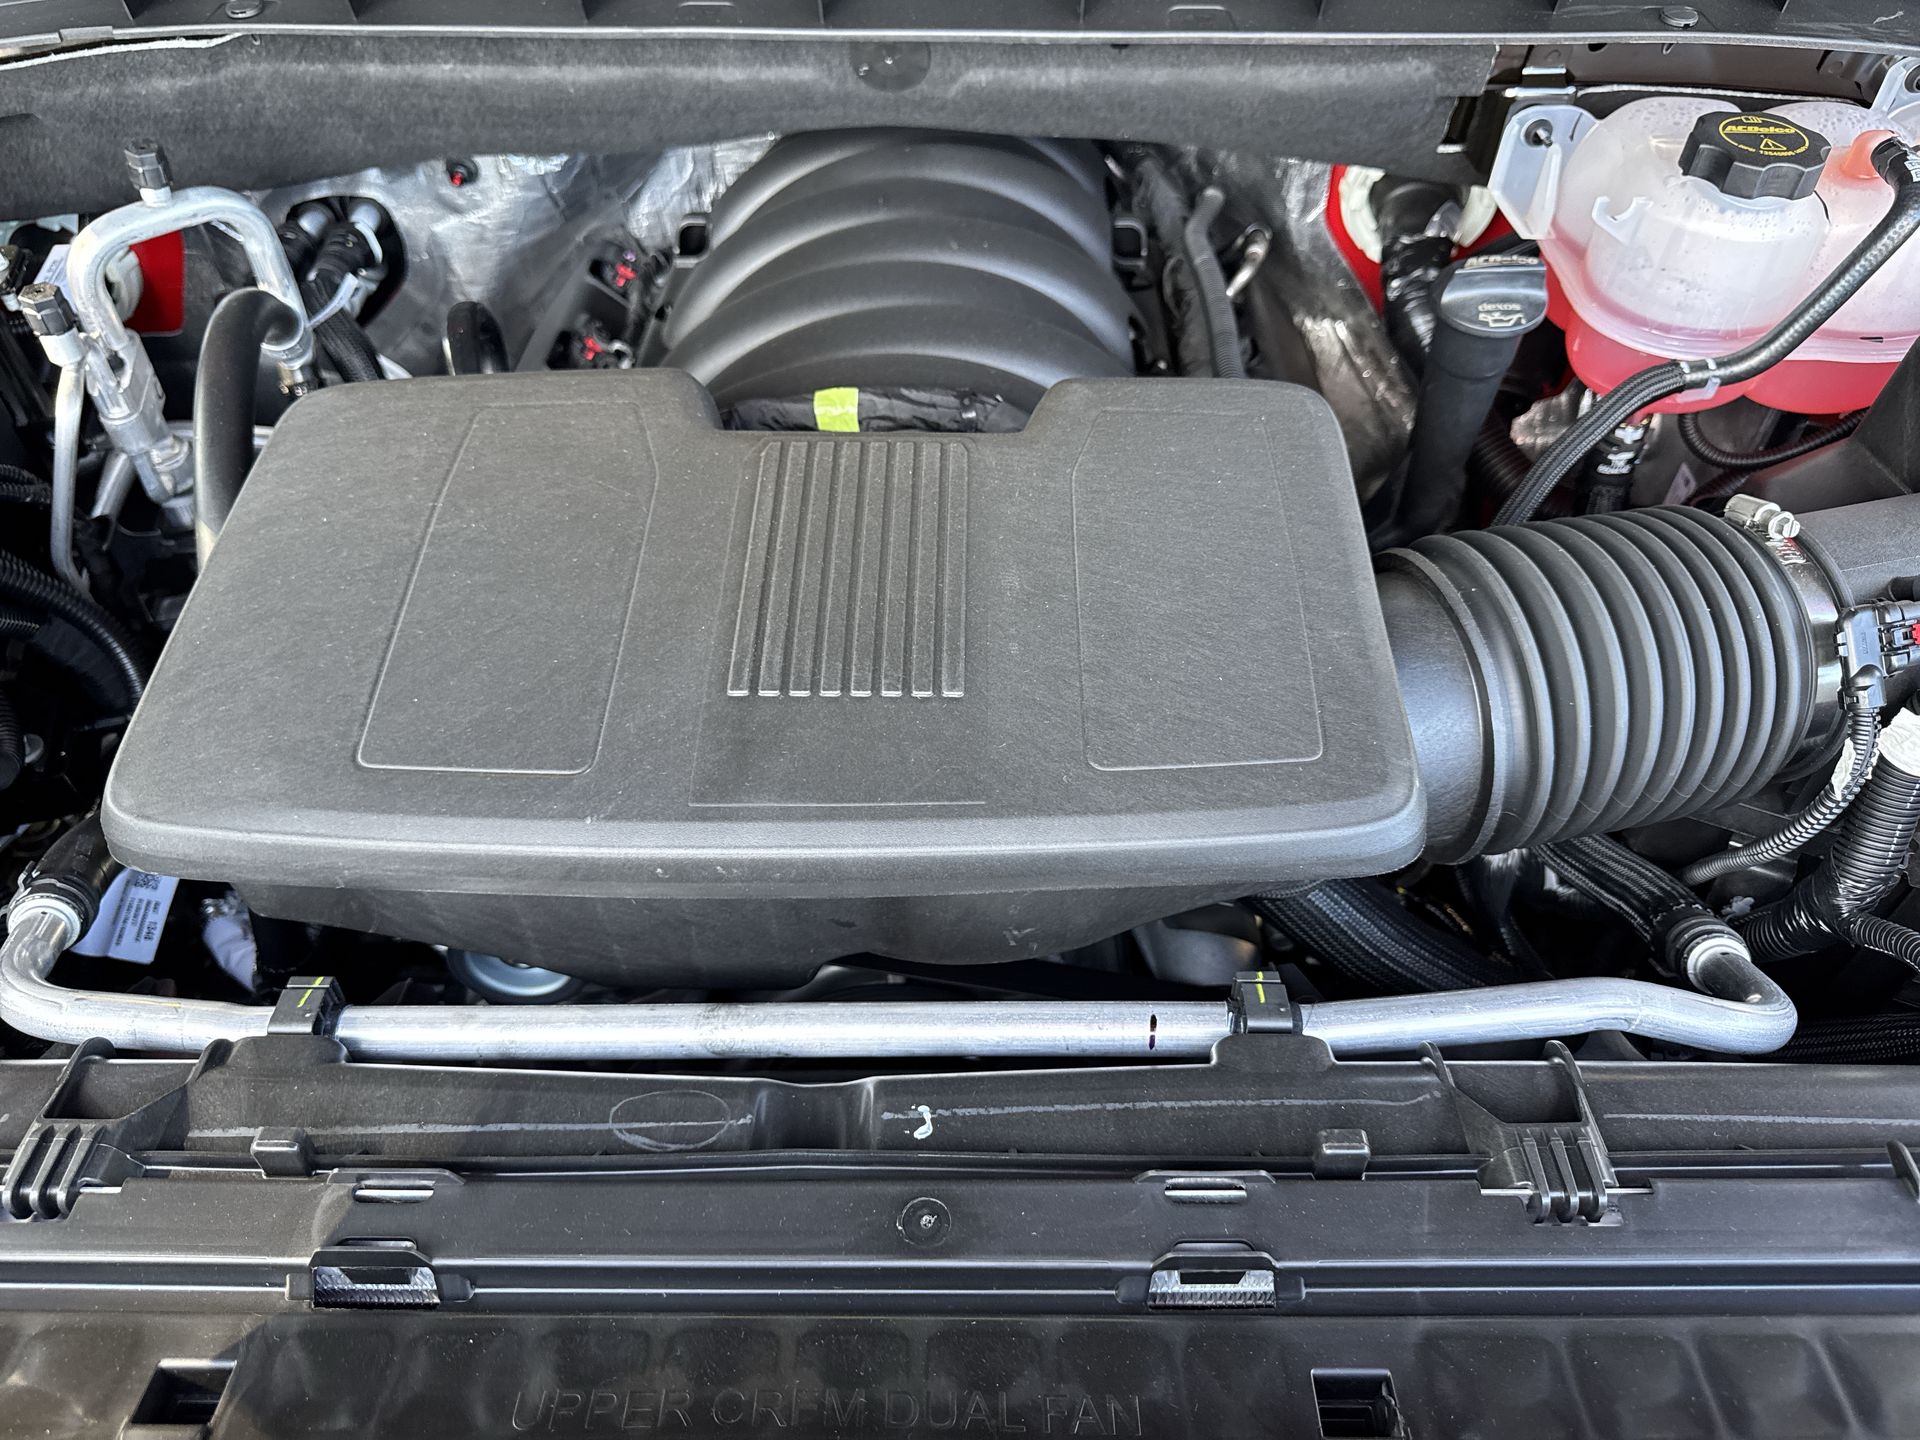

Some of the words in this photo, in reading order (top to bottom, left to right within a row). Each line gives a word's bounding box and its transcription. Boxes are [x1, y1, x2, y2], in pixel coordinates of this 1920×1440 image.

[1723, 125, 1796, 134] ACDelco
[511, 1388, 693, 1431] UPPER
[884, 1389, 1027, 1434] DUAL
[1043, 1393, 1143, 1437] FAN
